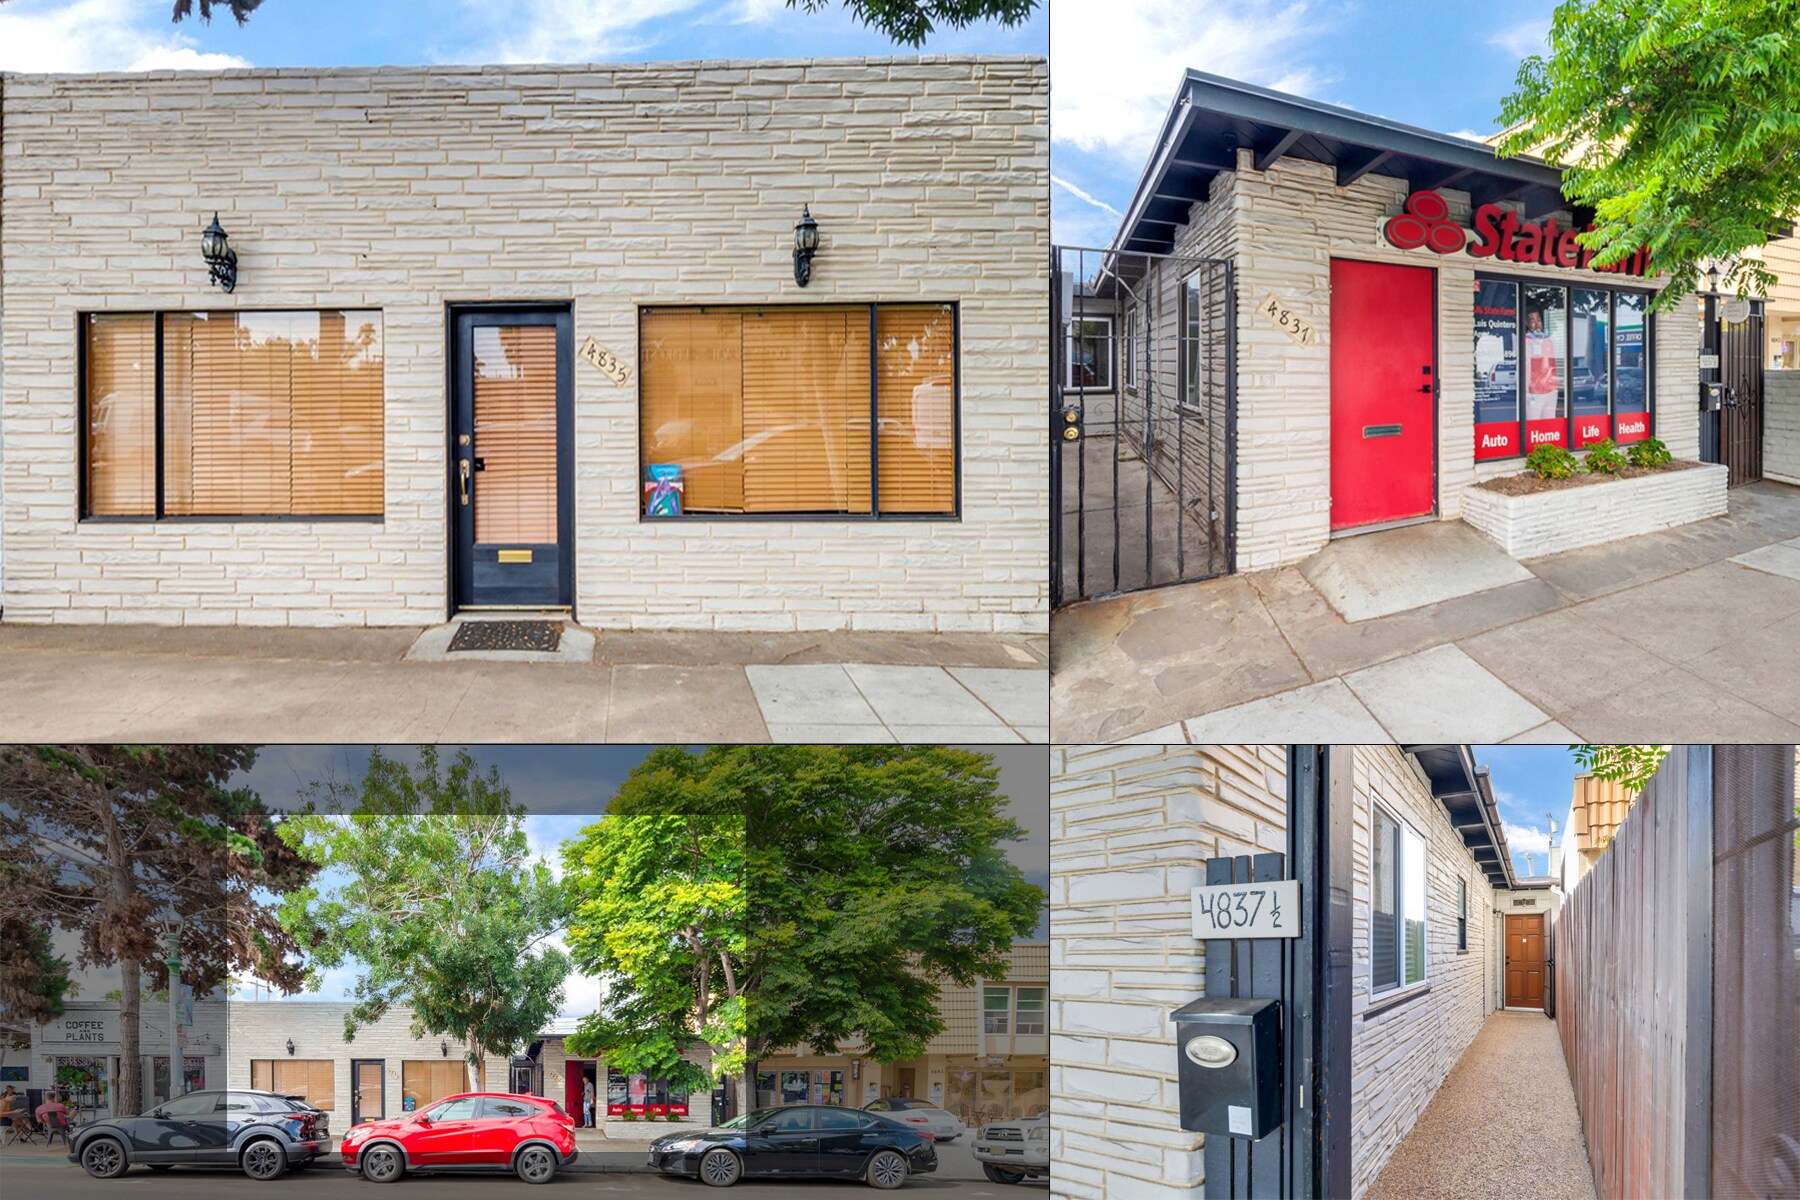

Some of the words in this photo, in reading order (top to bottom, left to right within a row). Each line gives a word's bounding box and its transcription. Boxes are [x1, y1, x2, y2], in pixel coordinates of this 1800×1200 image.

[1469, 203, 1582, 268] State
[1488, 319, 1516, 329] Quintero
[587, 343, 627, 382] 4835
[1482, 434, 1508, 448] Auto
[1531, 430, 1560, 443] Home
[1582, 426, 1600, 438] Life
[1618, 421, 1645, 435] Health
[1199, 891, 1266, 929] 4837
[65, 1021, 104, 1029] COFFEE
[65, 1032, 104, 1041] PLANTS
[1200, 1047, 1218, 1056] Mail
